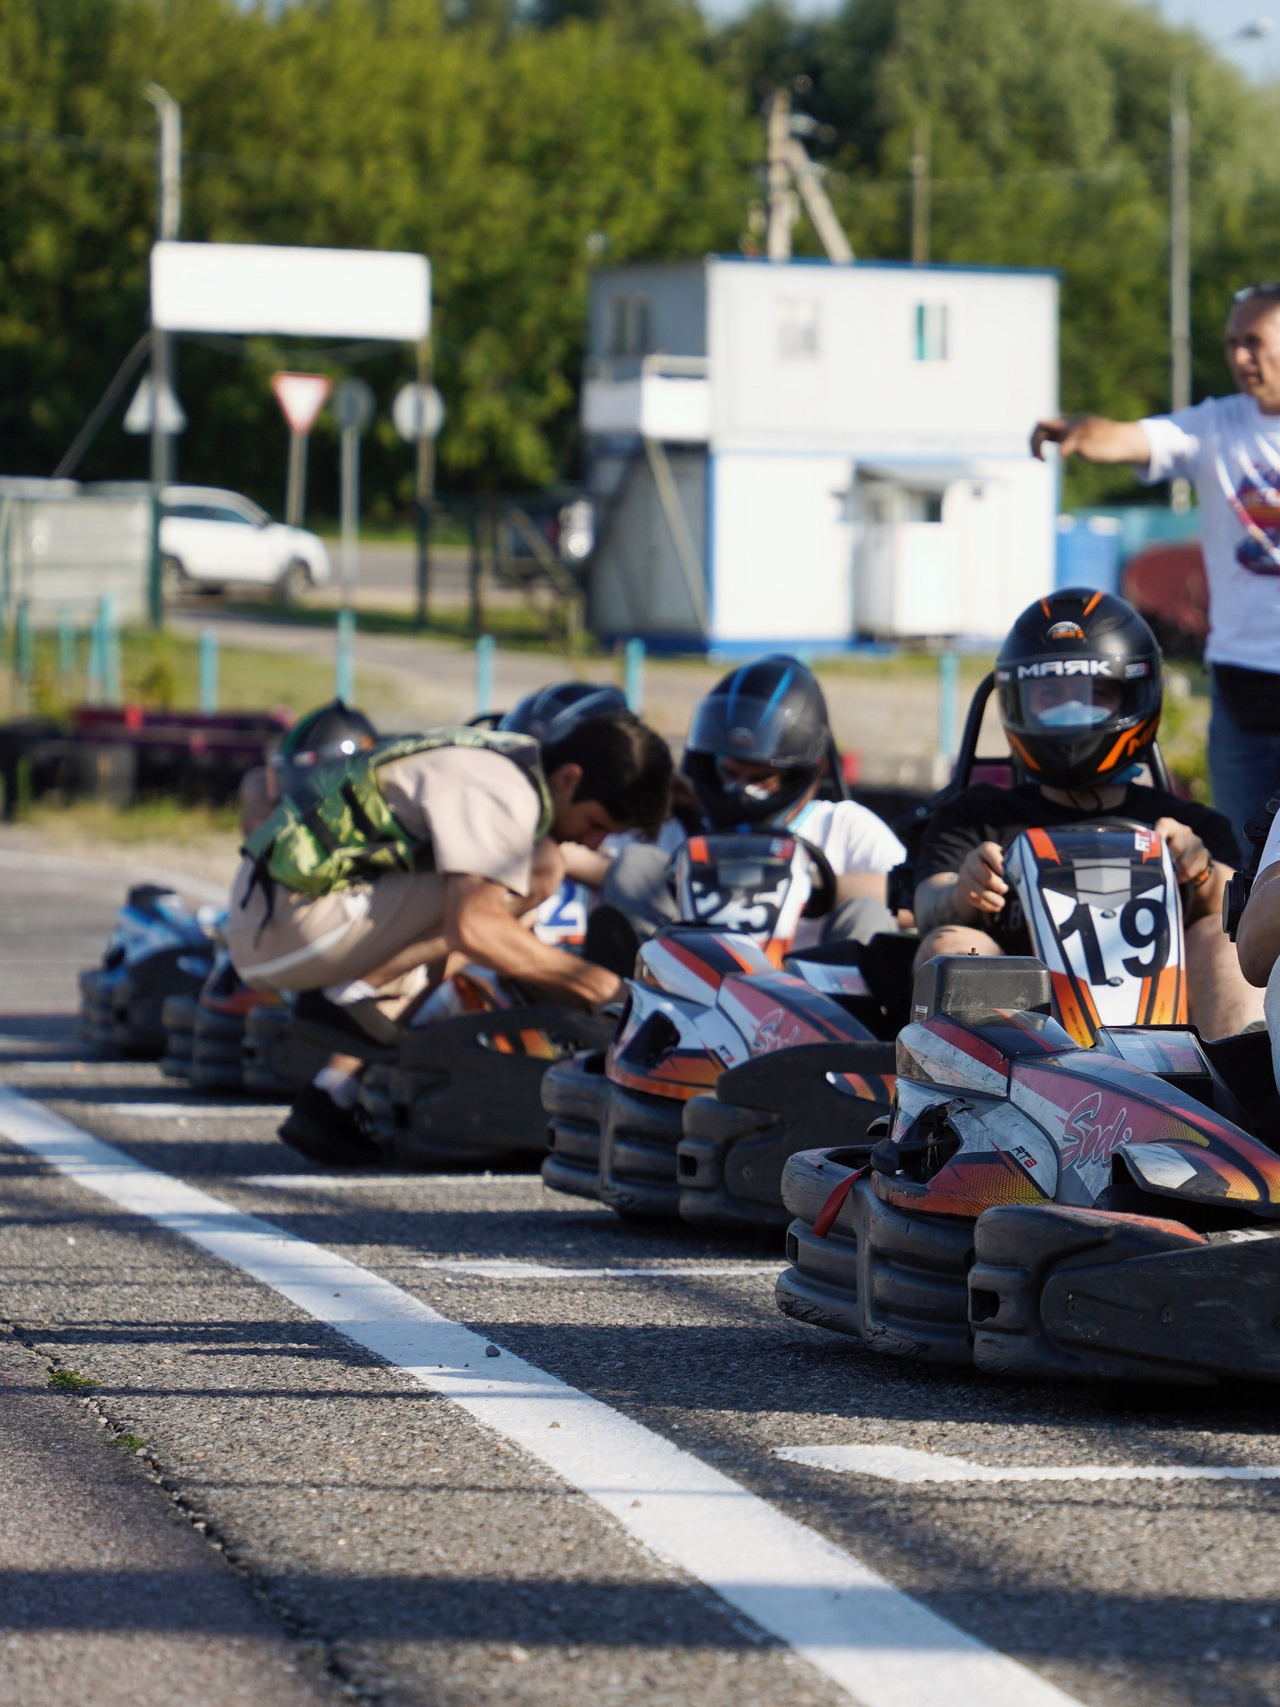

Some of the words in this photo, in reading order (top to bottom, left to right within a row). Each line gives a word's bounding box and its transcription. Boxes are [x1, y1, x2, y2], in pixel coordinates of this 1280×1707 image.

[1017, 660, 1114, 680] МАЯК
[1058, 898, 1171, 986] 19
[1061, 1091, 1133, 1170] Sodi
[1011, 1145, 1038, 1168] RT8
